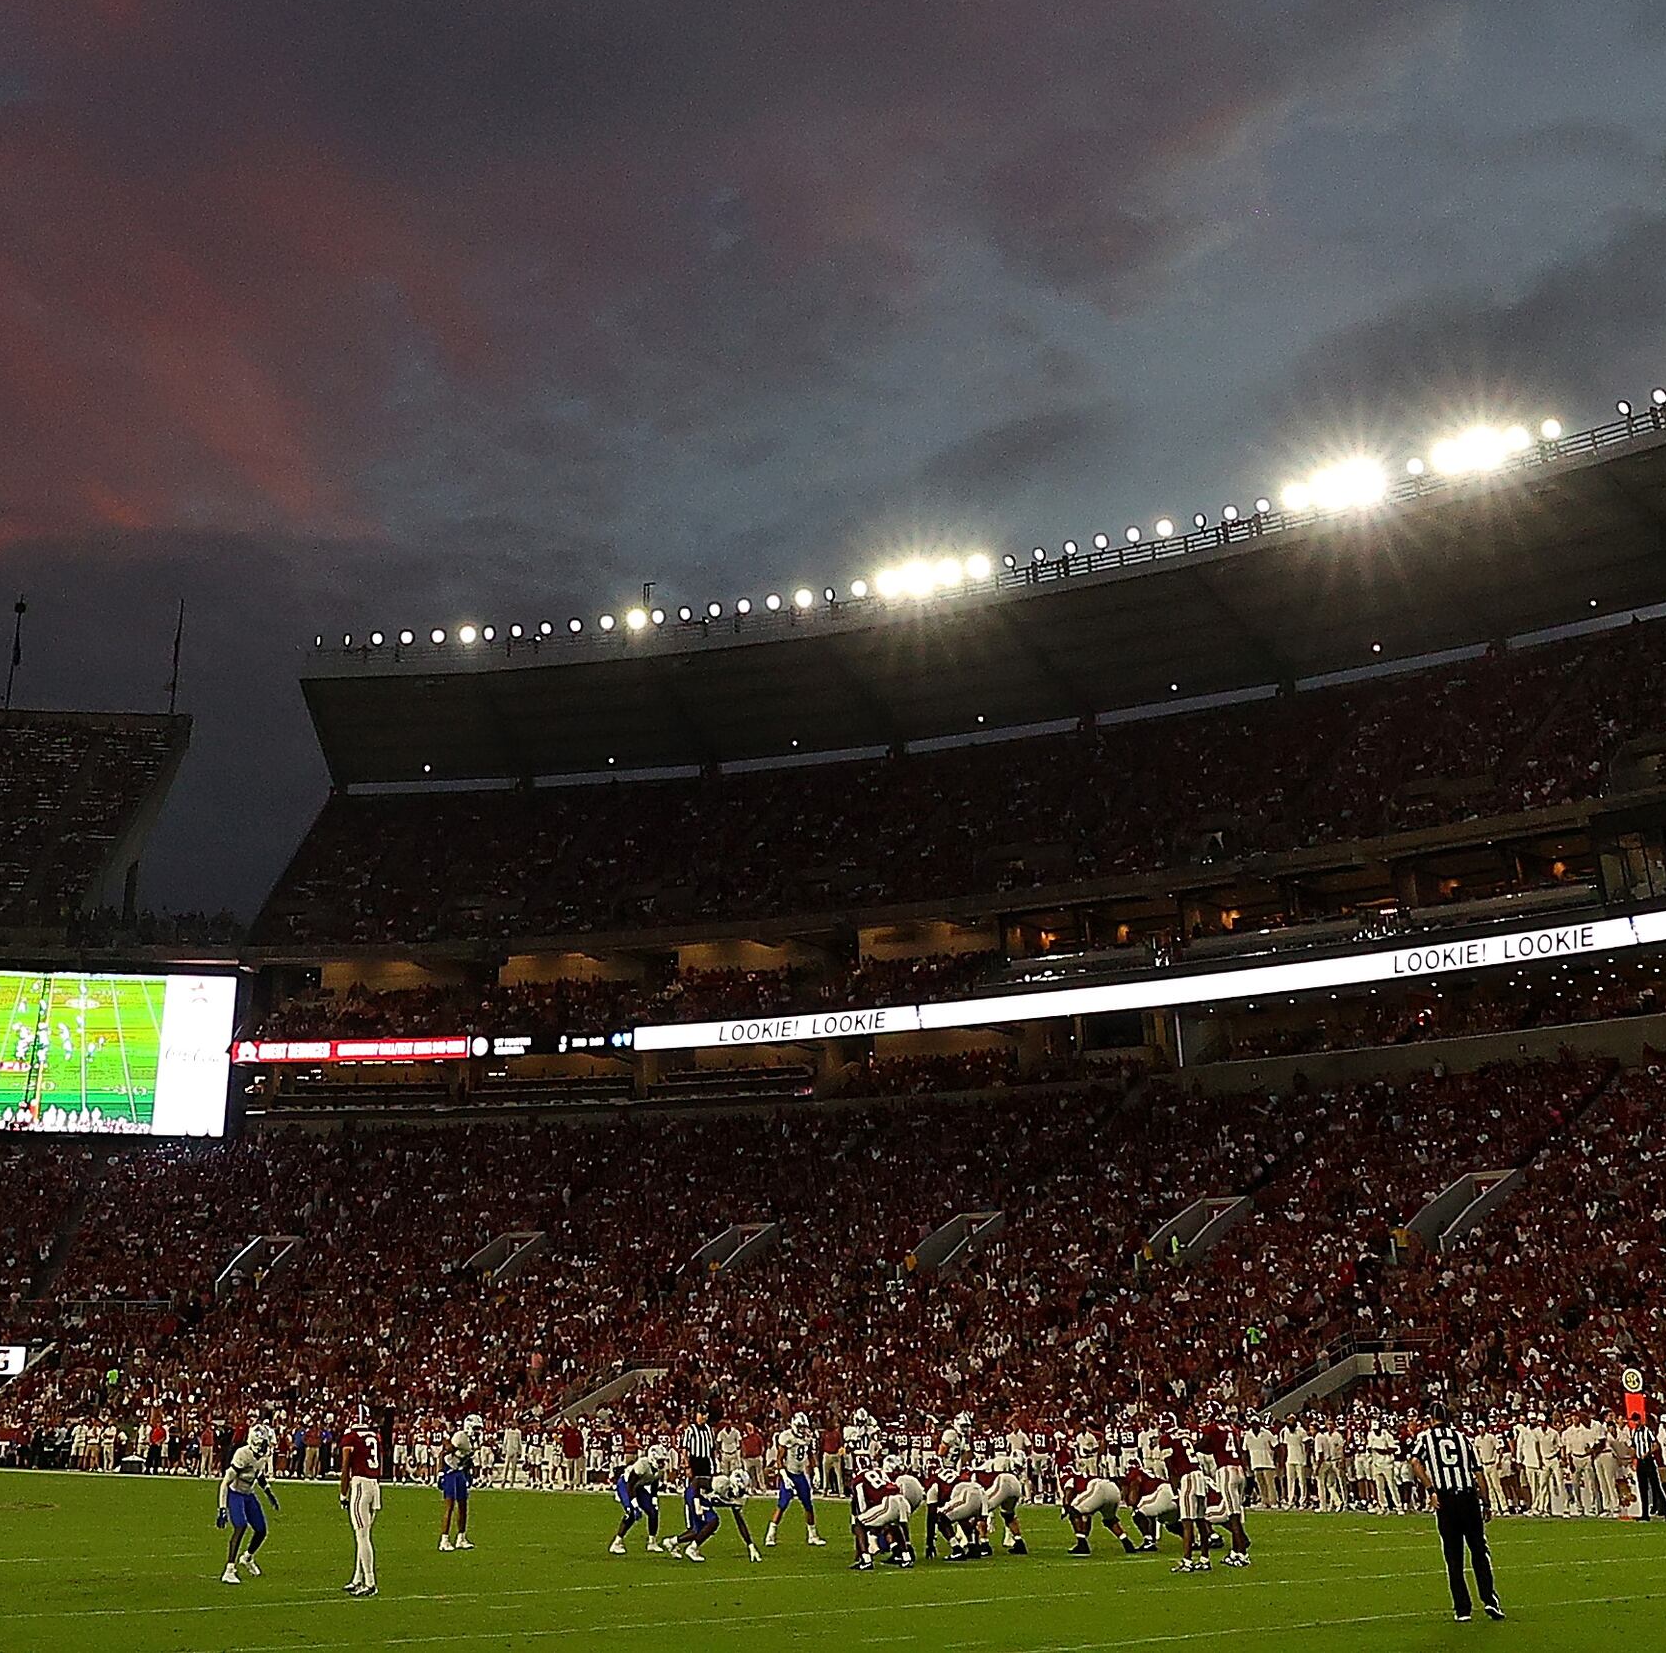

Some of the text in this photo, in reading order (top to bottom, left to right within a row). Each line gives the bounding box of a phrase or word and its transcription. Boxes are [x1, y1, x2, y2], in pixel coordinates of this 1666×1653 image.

[1394, 926, 1594, 974] LOOKIE! LOOKIE
[719, 1012, 886, 1042] LOOKIE! LOOKIE
[365, 1435, 380, 1469] 3
[1034, 1434, 1046, 1447] 61
[1182, 1438, 1199, 1464] 2
[1225, 1432, 1239, 1458] 4
[1438, 1439, 1458, 1465] C
